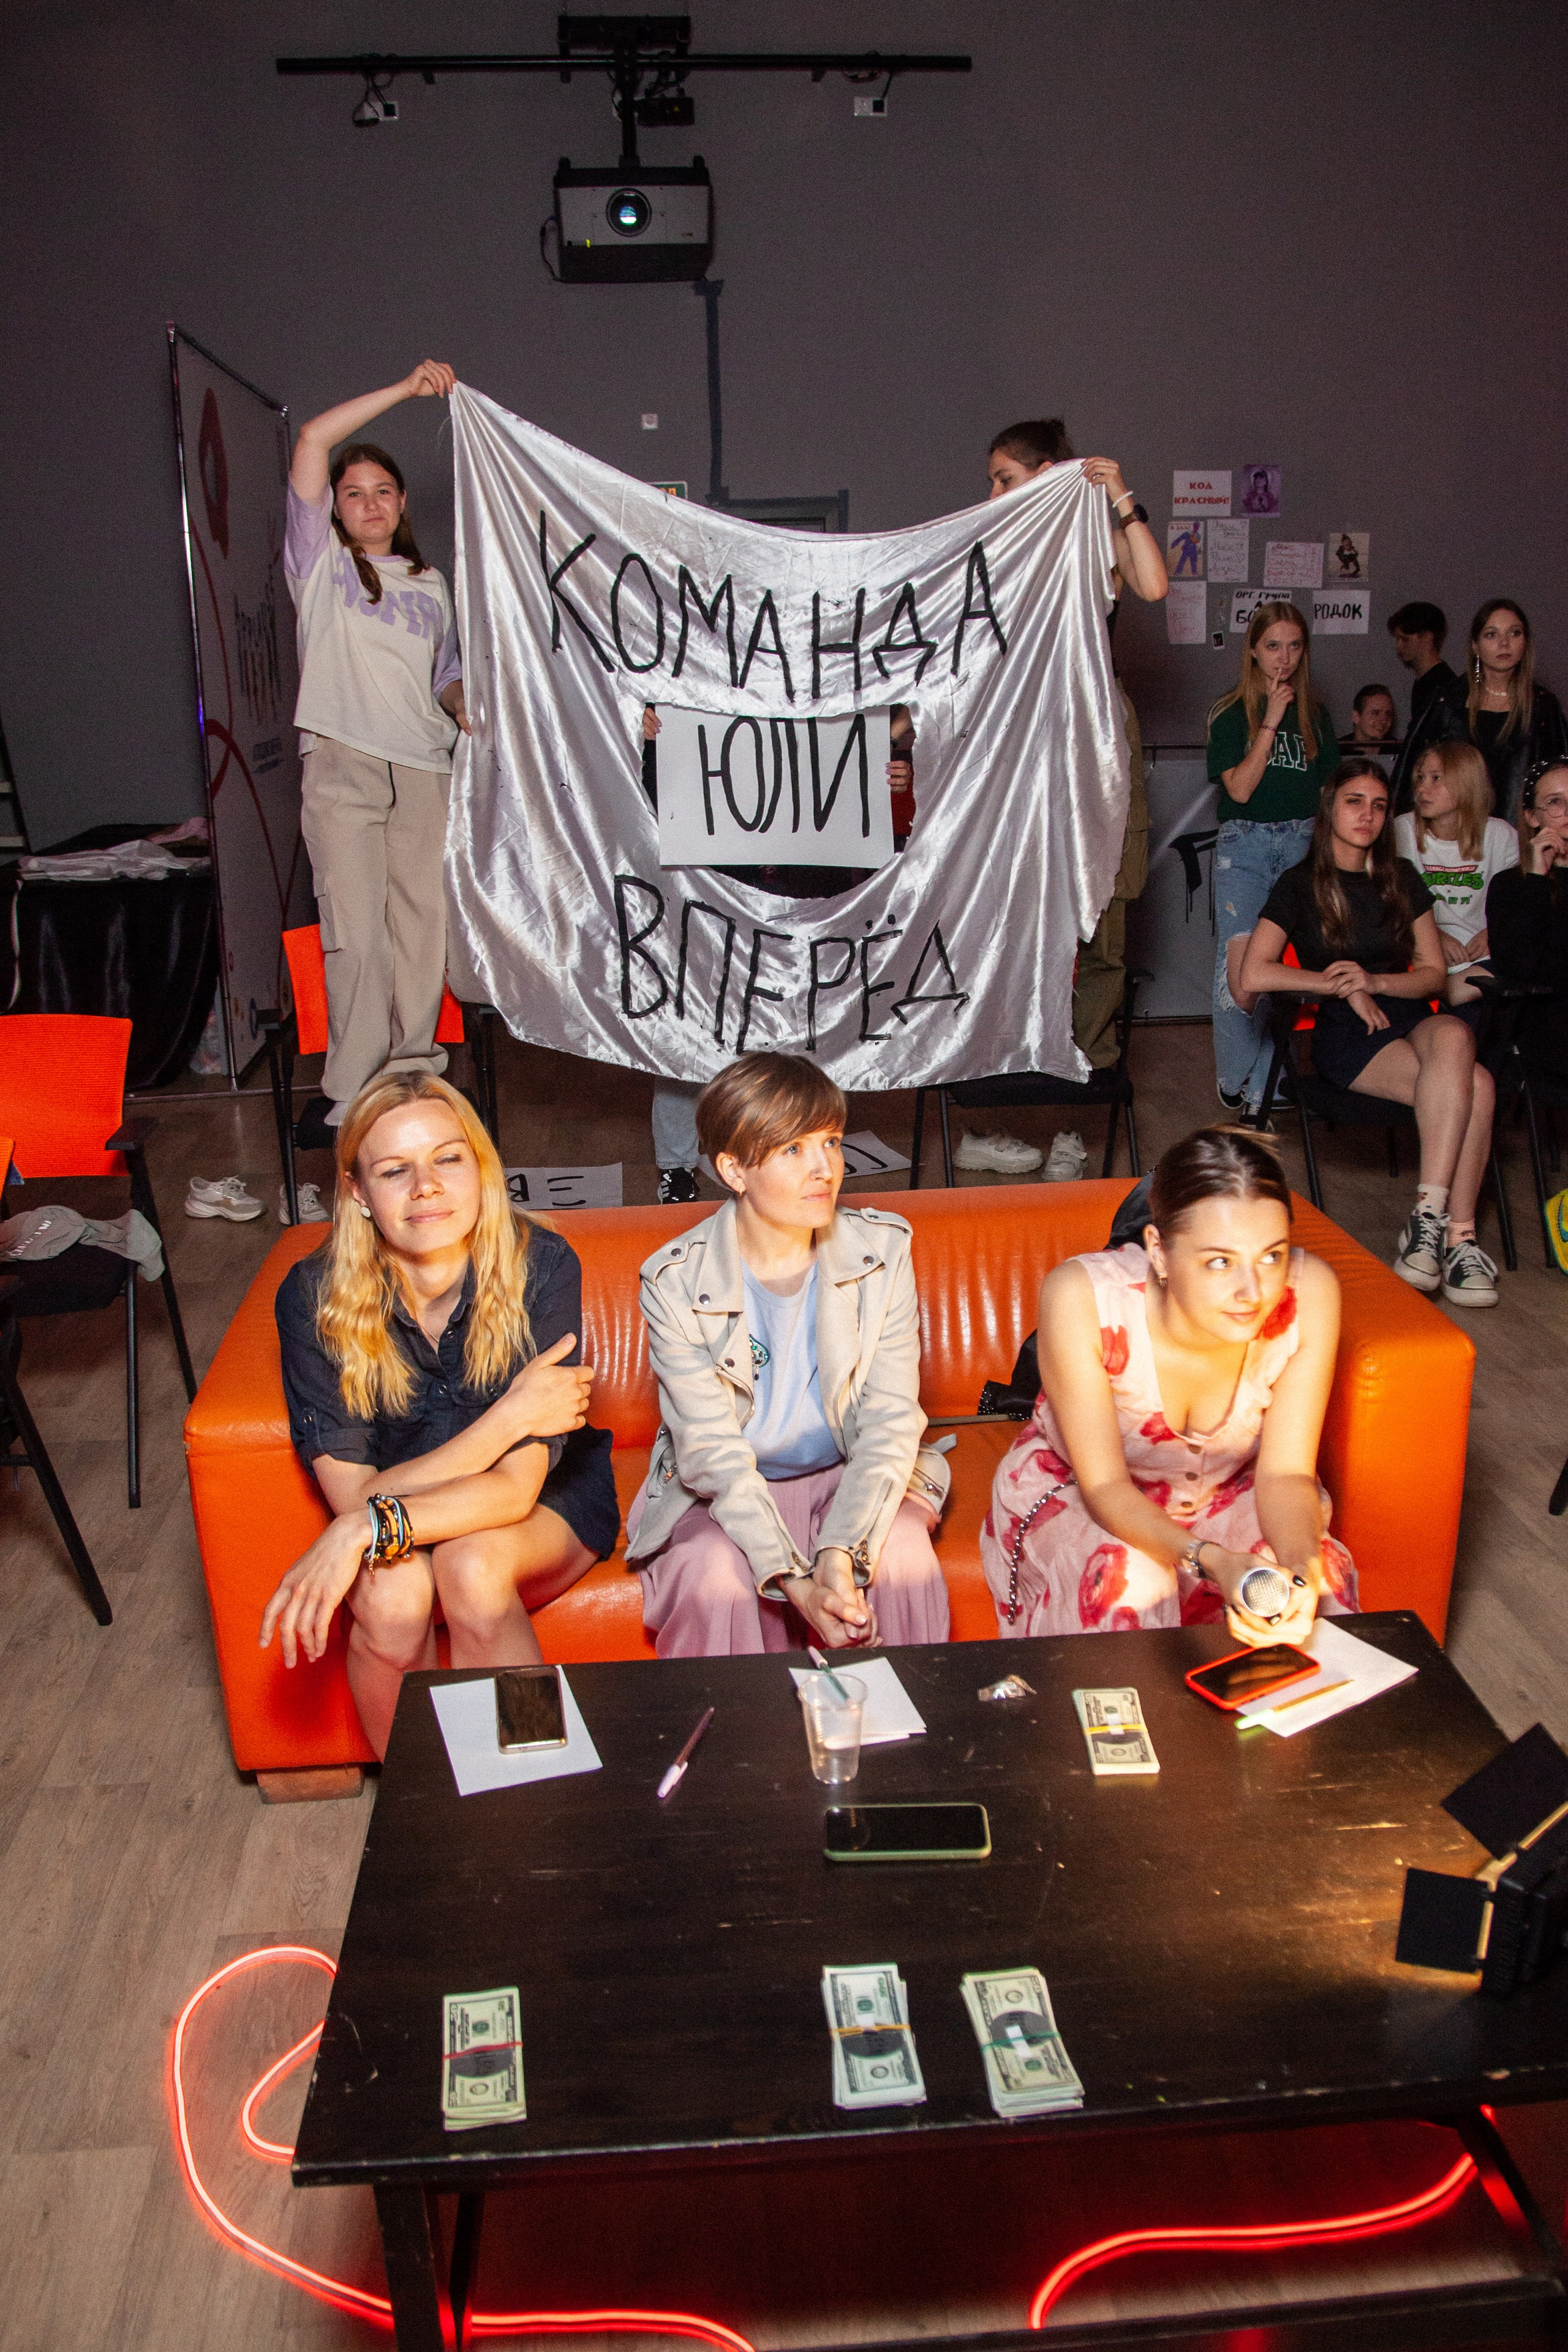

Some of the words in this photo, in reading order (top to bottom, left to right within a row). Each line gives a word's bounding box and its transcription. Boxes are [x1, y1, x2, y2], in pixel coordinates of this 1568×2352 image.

[540, 509, 1008, 703] КОМАНДА
[698, 712, 870, 837] ЮЛИ
[614, 874, 970, 1054] ВПЕРЁД
